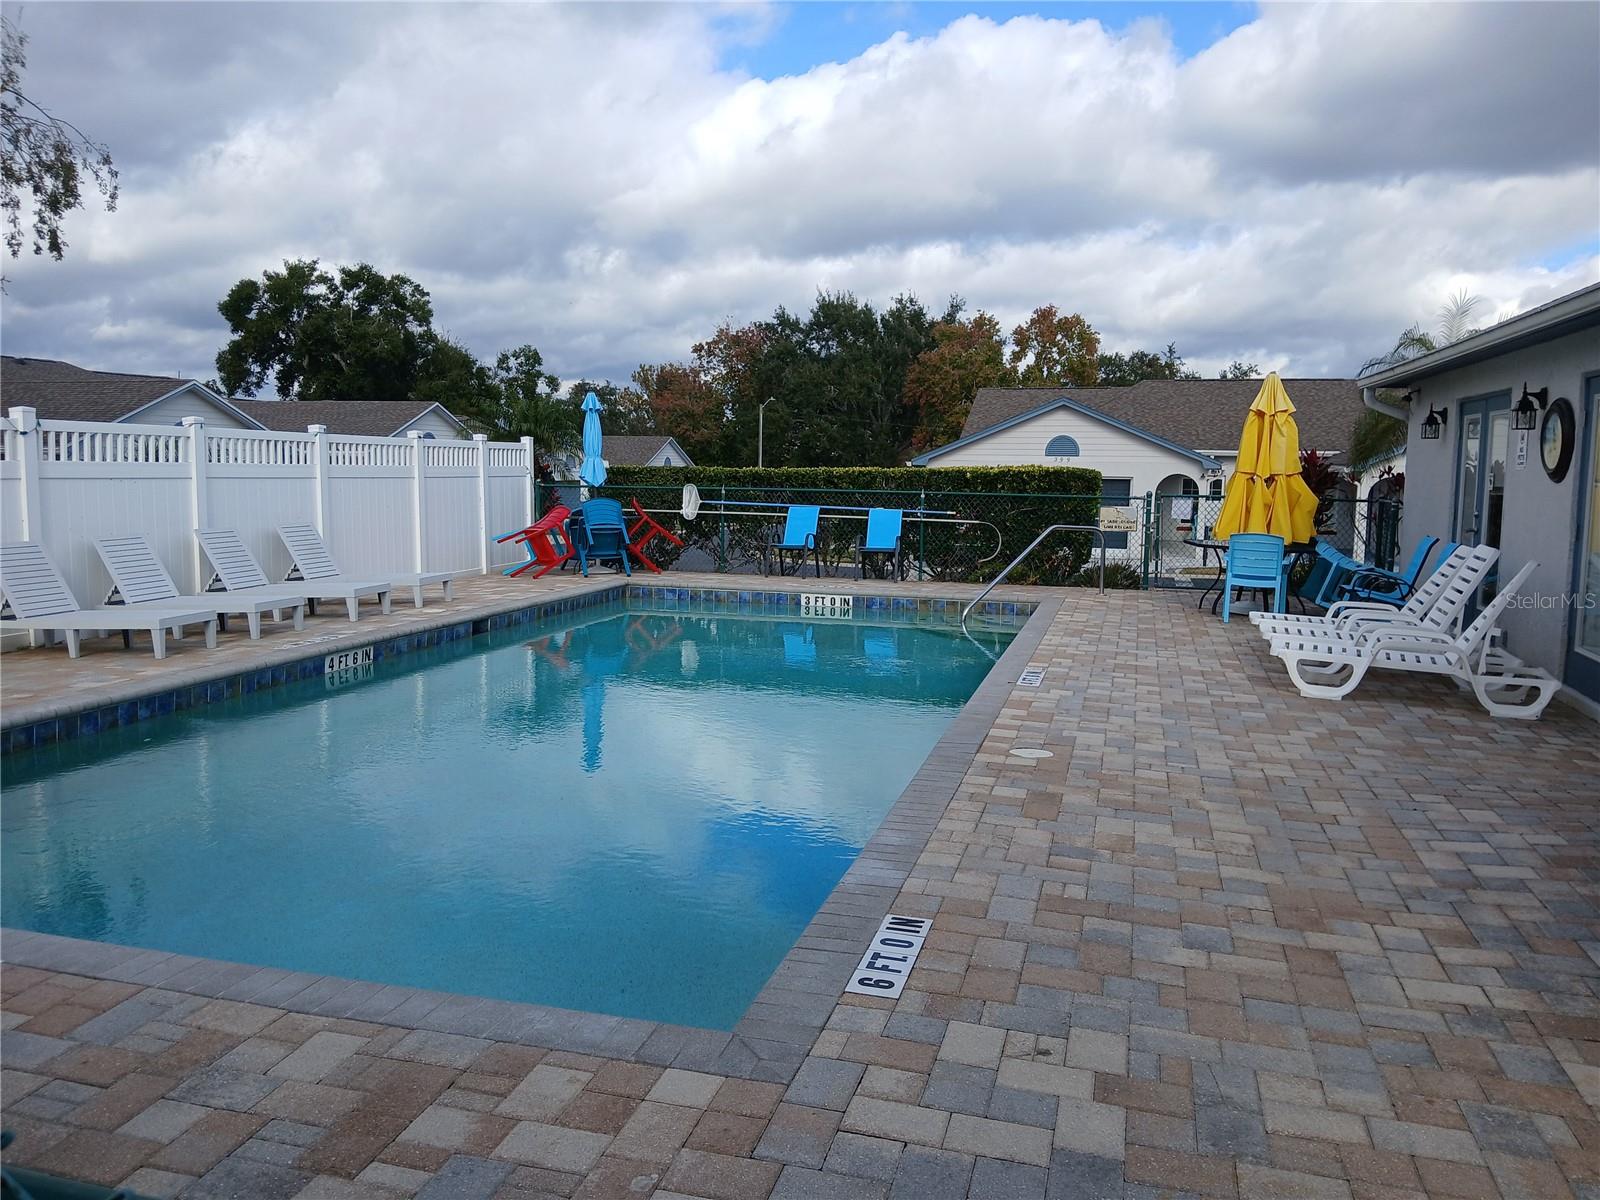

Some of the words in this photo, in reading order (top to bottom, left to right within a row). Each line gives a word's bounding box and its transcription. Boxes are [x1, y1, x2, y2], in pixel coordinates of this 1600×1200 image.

[804, 596, 810, 605] 3
[329, 657, 334, 671] 4
[352, 651, 358, 665] 6
[858, 977, 895, 989] 6
[885, 916, 925, 934] IN
